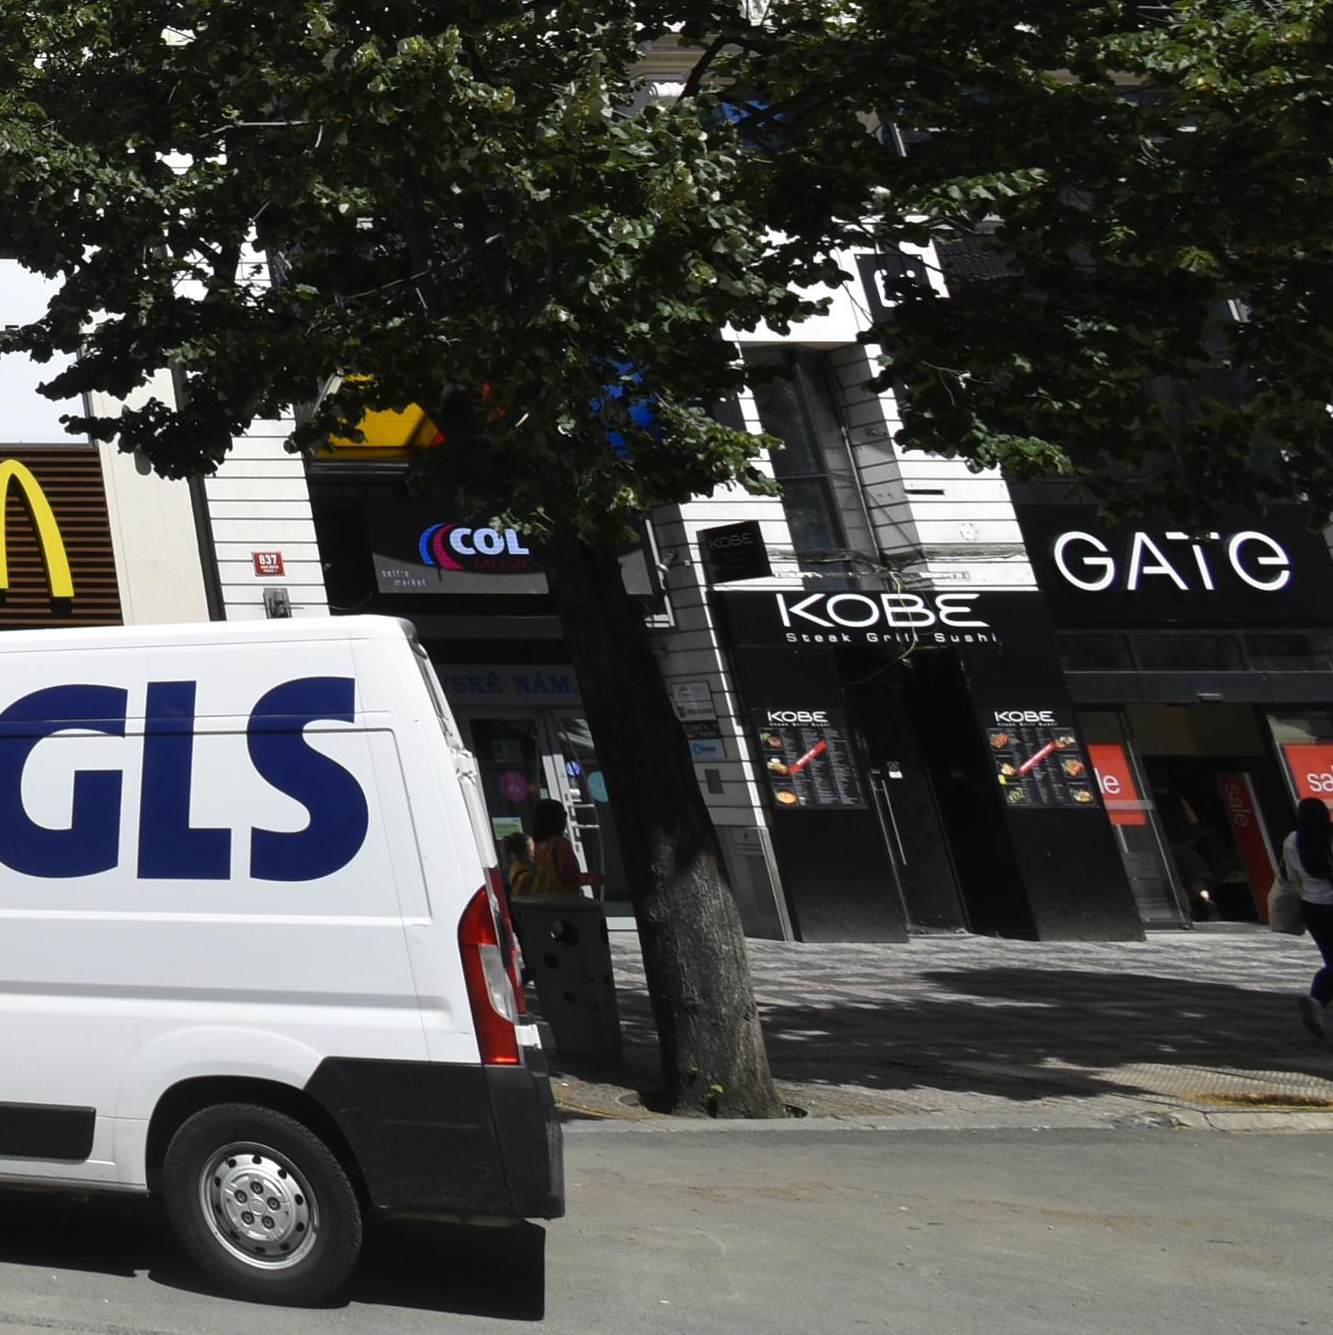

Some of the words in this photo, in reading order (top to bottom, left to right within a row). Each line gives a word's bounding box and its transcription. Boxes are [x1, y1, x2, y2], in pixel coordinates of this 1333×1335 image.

[708, 530, 753, 549] KOBE
[258, 554, 277, 565] 837
[394, 578, 426, 587] market
[775, 593, 990, 627] KOBE
[786, 632, 852, 643] Steak
[866, 632, 919, 643] Grill
[934, 632, 998, 643] Sushi
[767, 711, 829, 722] KOBE
[994, 711, 1056, 722] KOBE
